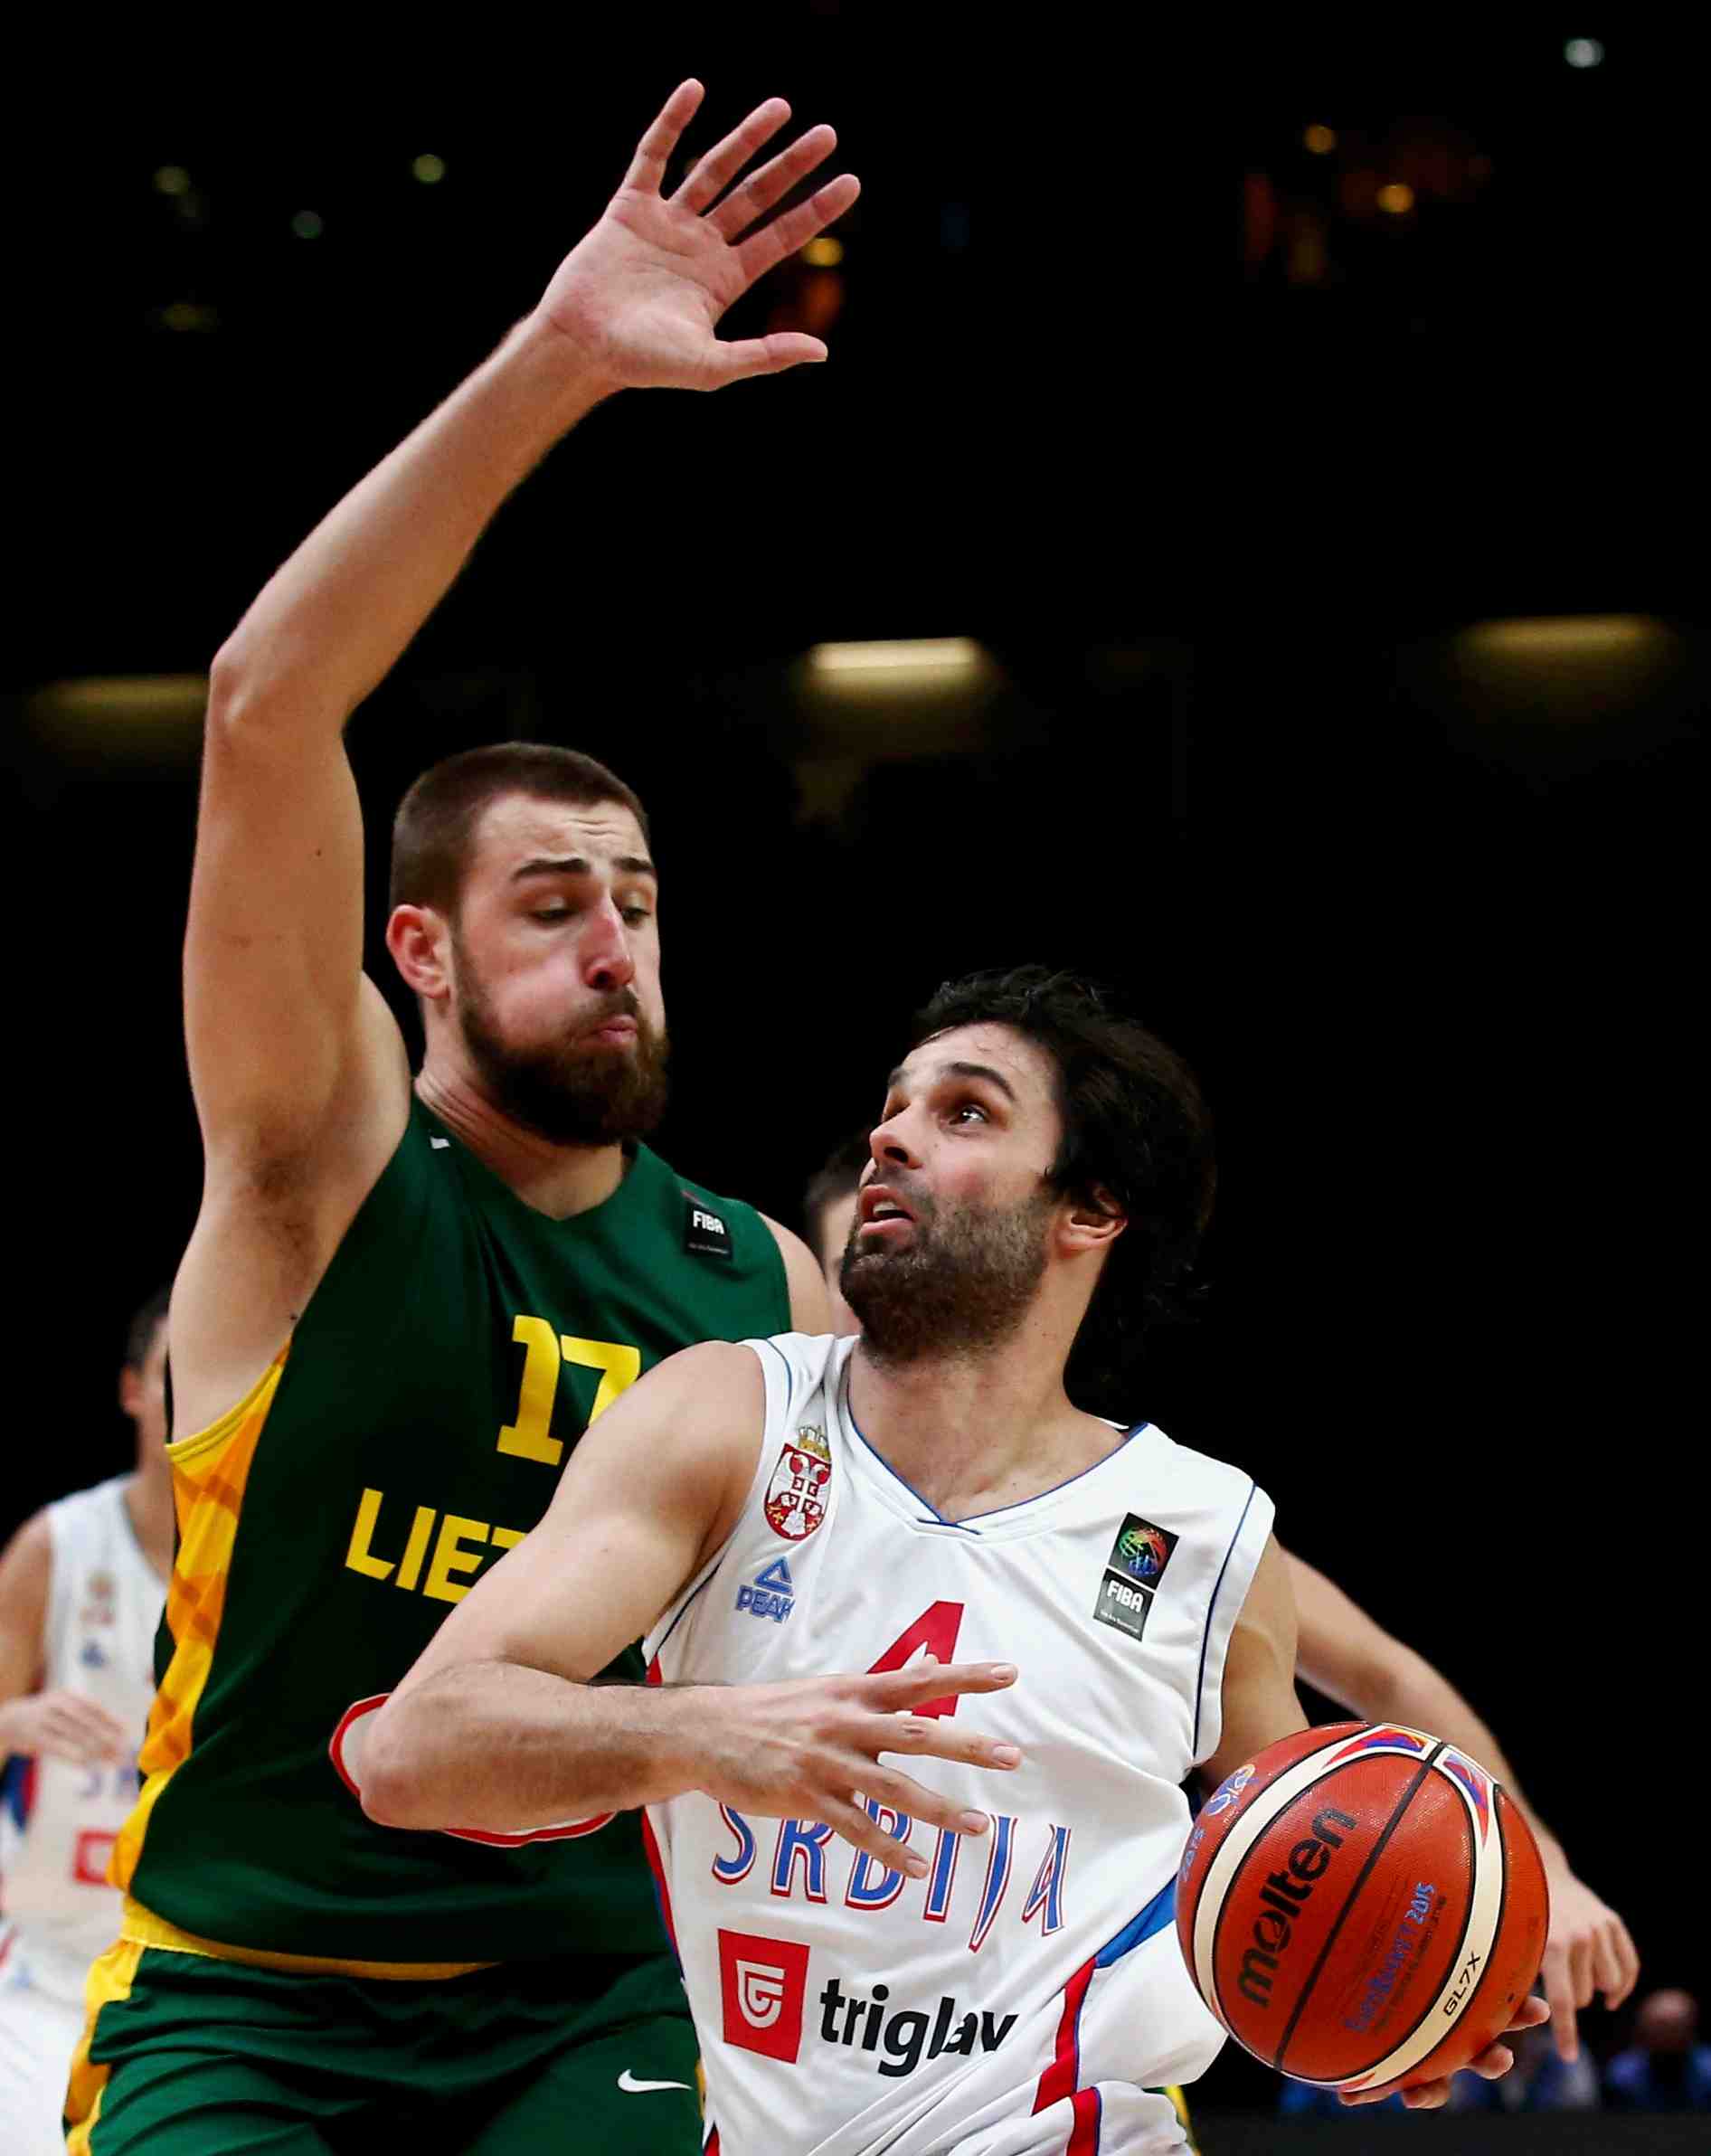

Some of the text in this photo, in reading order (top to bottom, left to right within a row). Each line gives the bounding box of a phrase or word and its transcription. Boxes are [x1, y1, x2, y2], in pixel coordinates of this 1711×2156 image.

[693, 1209, 724, 1235] FIBA
[496, 1314, 640, 1466] 17
[735, 1584, 795, 1624] PEAK
[1106, 1578, 1145, 1613] FIBA
[865, 1599, 965, 1719] 4
[1236, 1807, 1358, 2009] molten
[1443, 1951, 1481, 2017] GL7X
[820, 1978, 1020, 2077] triglav
